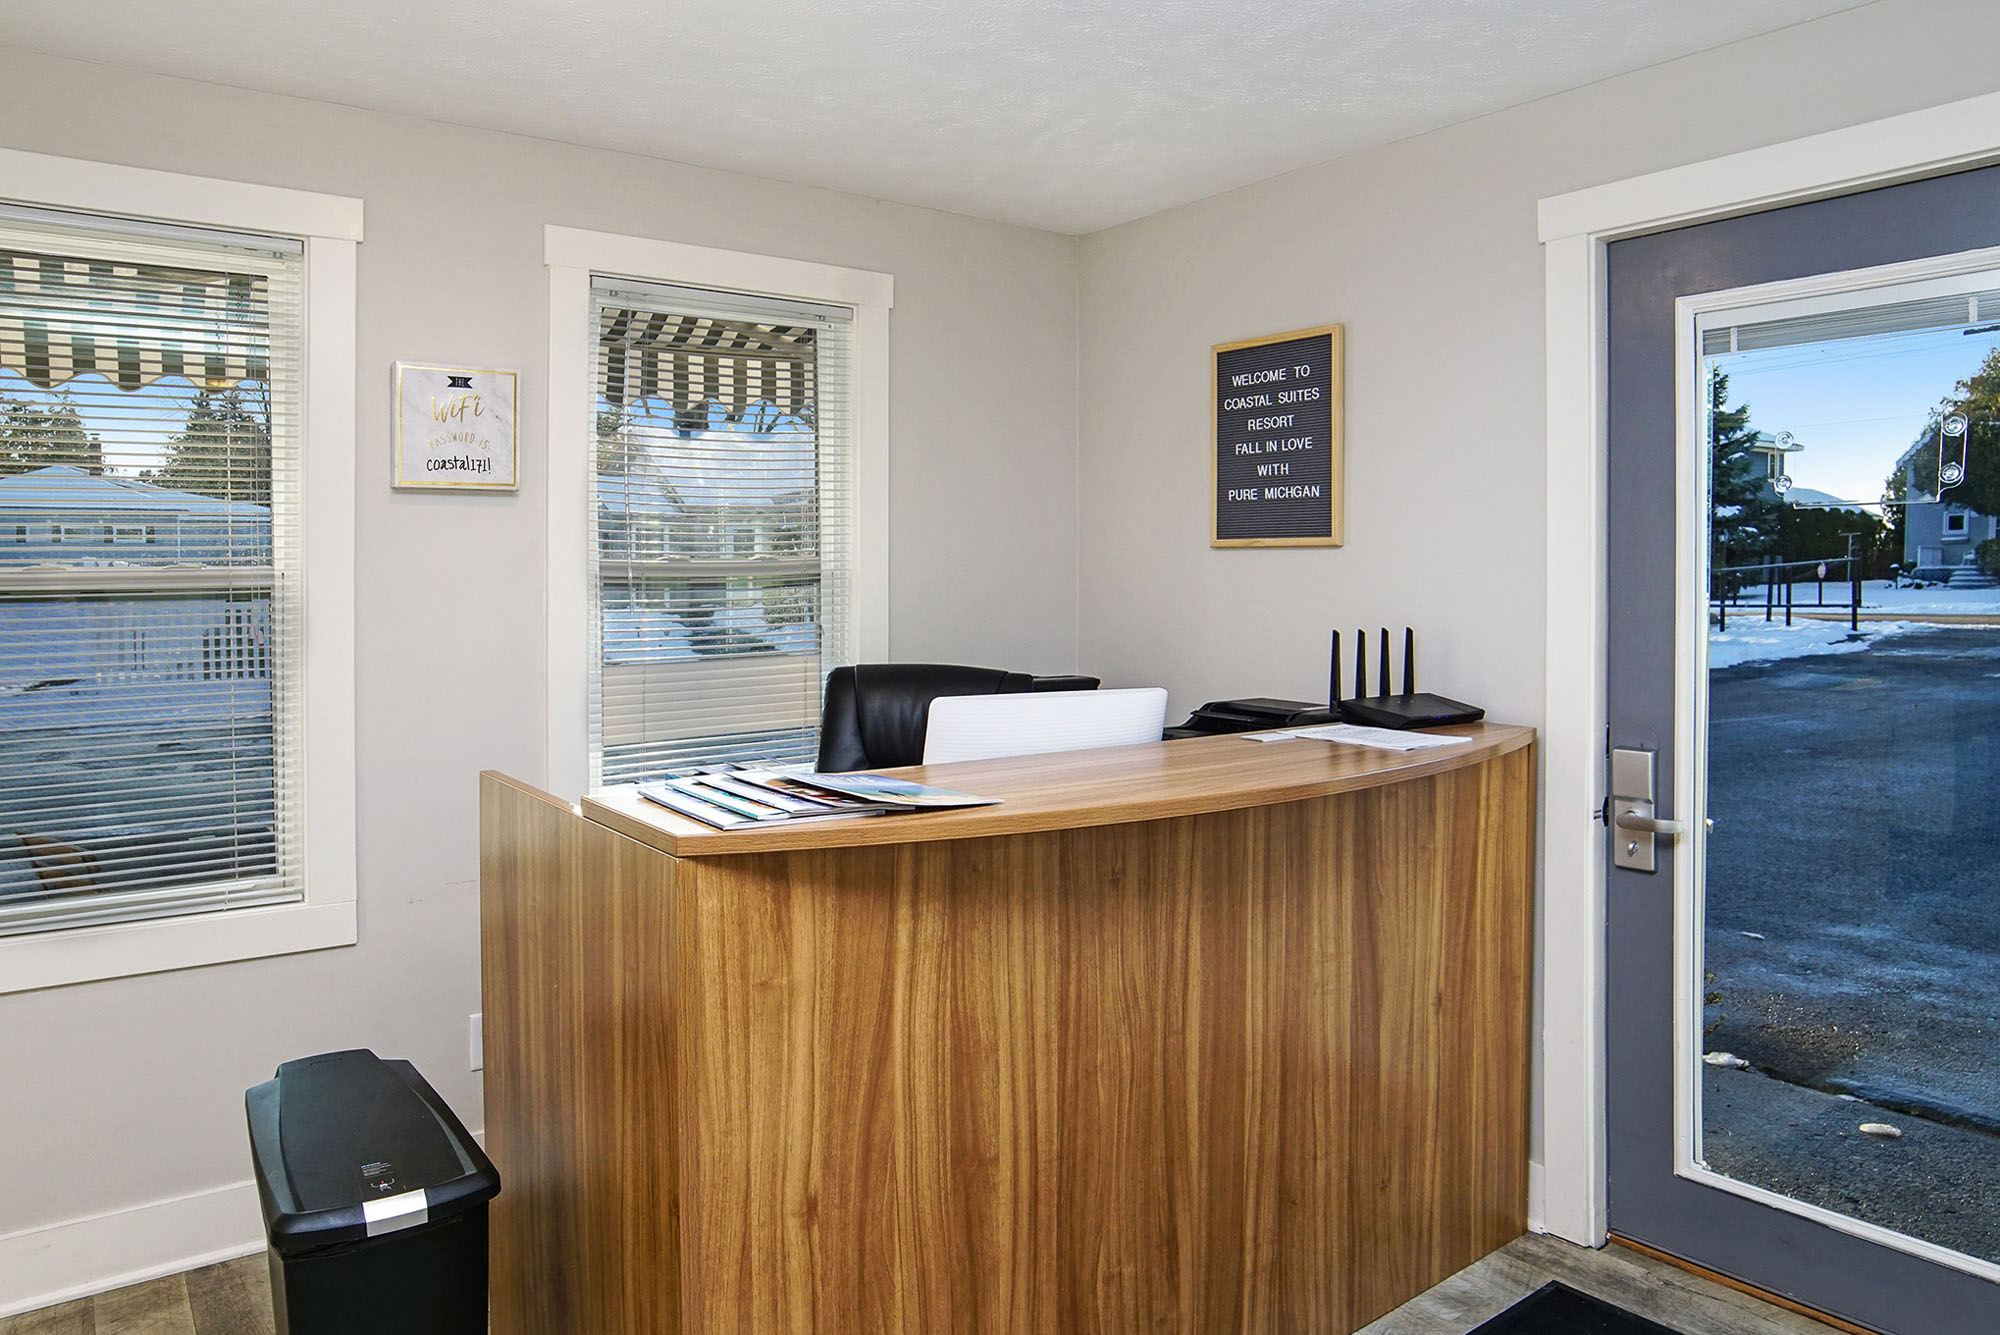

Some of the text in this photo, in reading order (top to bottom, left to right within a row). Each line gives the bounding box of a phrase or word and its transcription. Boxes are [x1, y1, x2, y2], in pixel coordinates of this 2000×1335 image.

[1232, 365, 1310, 387] WELCOME TO
[1224, 388, 1320, 410] COASTAL SUITES
[1248, 415, 1294, 430] RESORT
[1235, 437, 1312, 455] FALL IN LOVE
[1257, 463, 1289, 476] WITH
[1228, 485, 1320, 501] PURE MICHGAN
